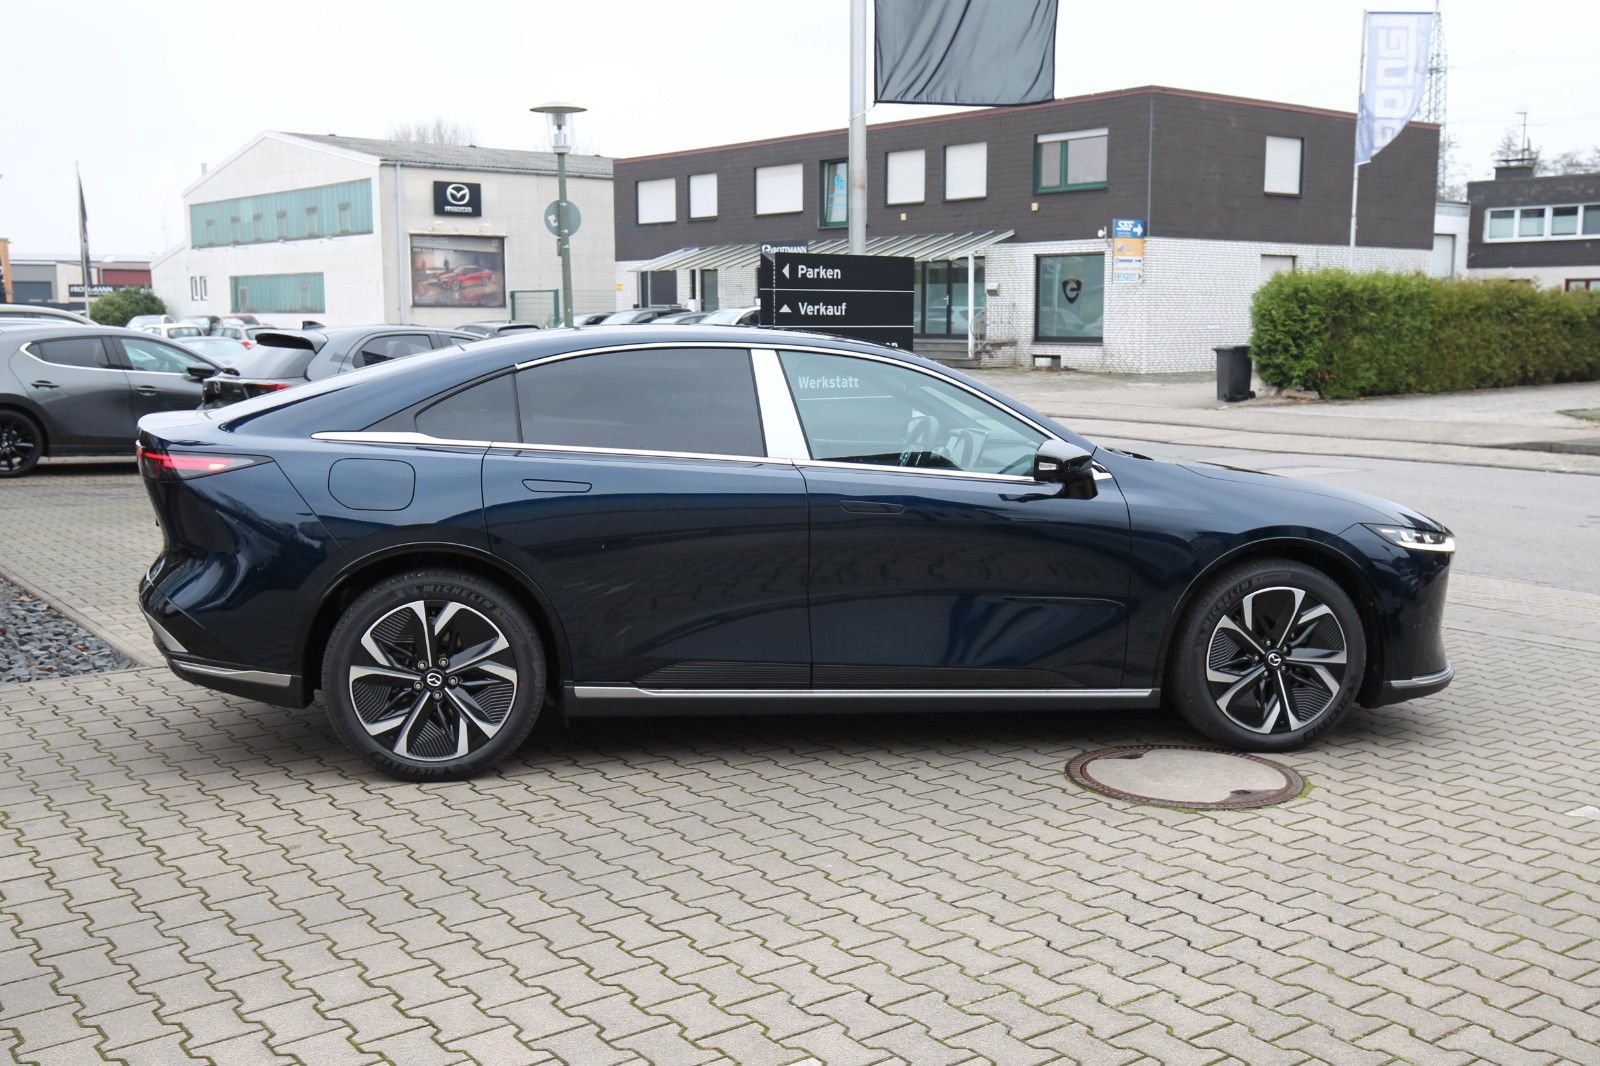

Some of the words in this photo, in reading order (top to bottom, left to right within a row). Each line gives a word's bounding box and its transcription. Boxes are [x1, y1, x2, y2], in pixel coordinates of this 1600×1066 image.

[798, 264, 841, 279] Parken
[798, 302, 847, 316] Verkauf
[798, 376, 860, 389] Werkstatt
